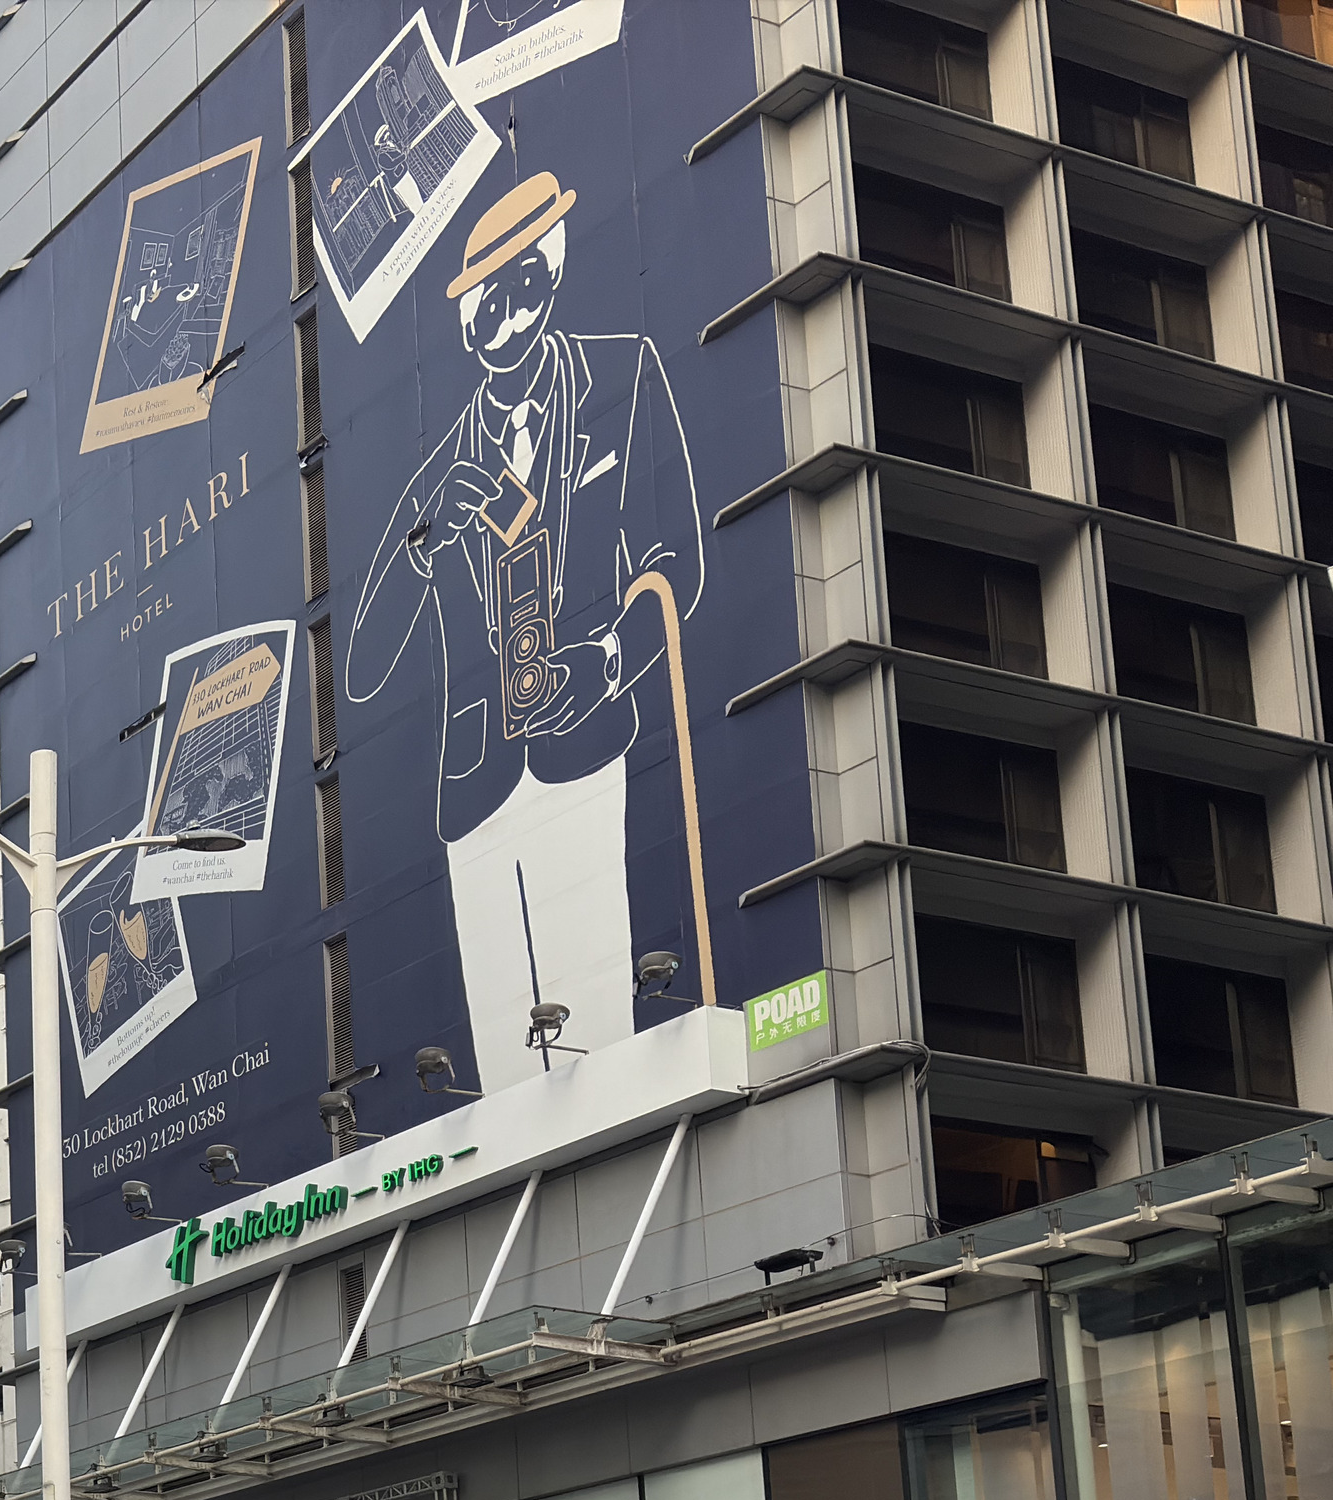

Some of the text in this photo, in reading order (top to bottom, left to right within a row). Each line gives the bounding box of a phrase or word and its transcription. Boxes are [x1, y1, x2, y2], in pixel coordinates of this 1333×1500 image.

[494, 49, 515, 67] Soak
[517, 43, 527, 56] in
[381, 271, 389, 282] A
[389, 241, 411, 270] room
[411, 215, 430, 240] with
[430, 207, 436, 215] a
[137, 405, 143, 414] &
[46, 451, 250, 639] THE HARI
[120, 593, 173, 642] HOTEL
[192, 656, 272, 707] 330 LOCKHART ROAD
[196, 681, 253, 719] WAN CHAI
[162, 867, 234, 886] #wanchai #theharihk
[172, 858, 193, 871] Come
[193, 857, 201, 868] to
[202, 856, 214, 868] find
[116, 1005, 156, 1046] Bottoms up!
[753, 980, 821, 1032] POAD
[107, 1010, 171, 1067] #thelounge #cheers
[63, 1042, 270, 1159] 30 Lockhart Road, Wan Chai
[92, 1101, 227, 1178] tel (852) 2129 0388
[382, 1154, 444, 1192] BY IHG
